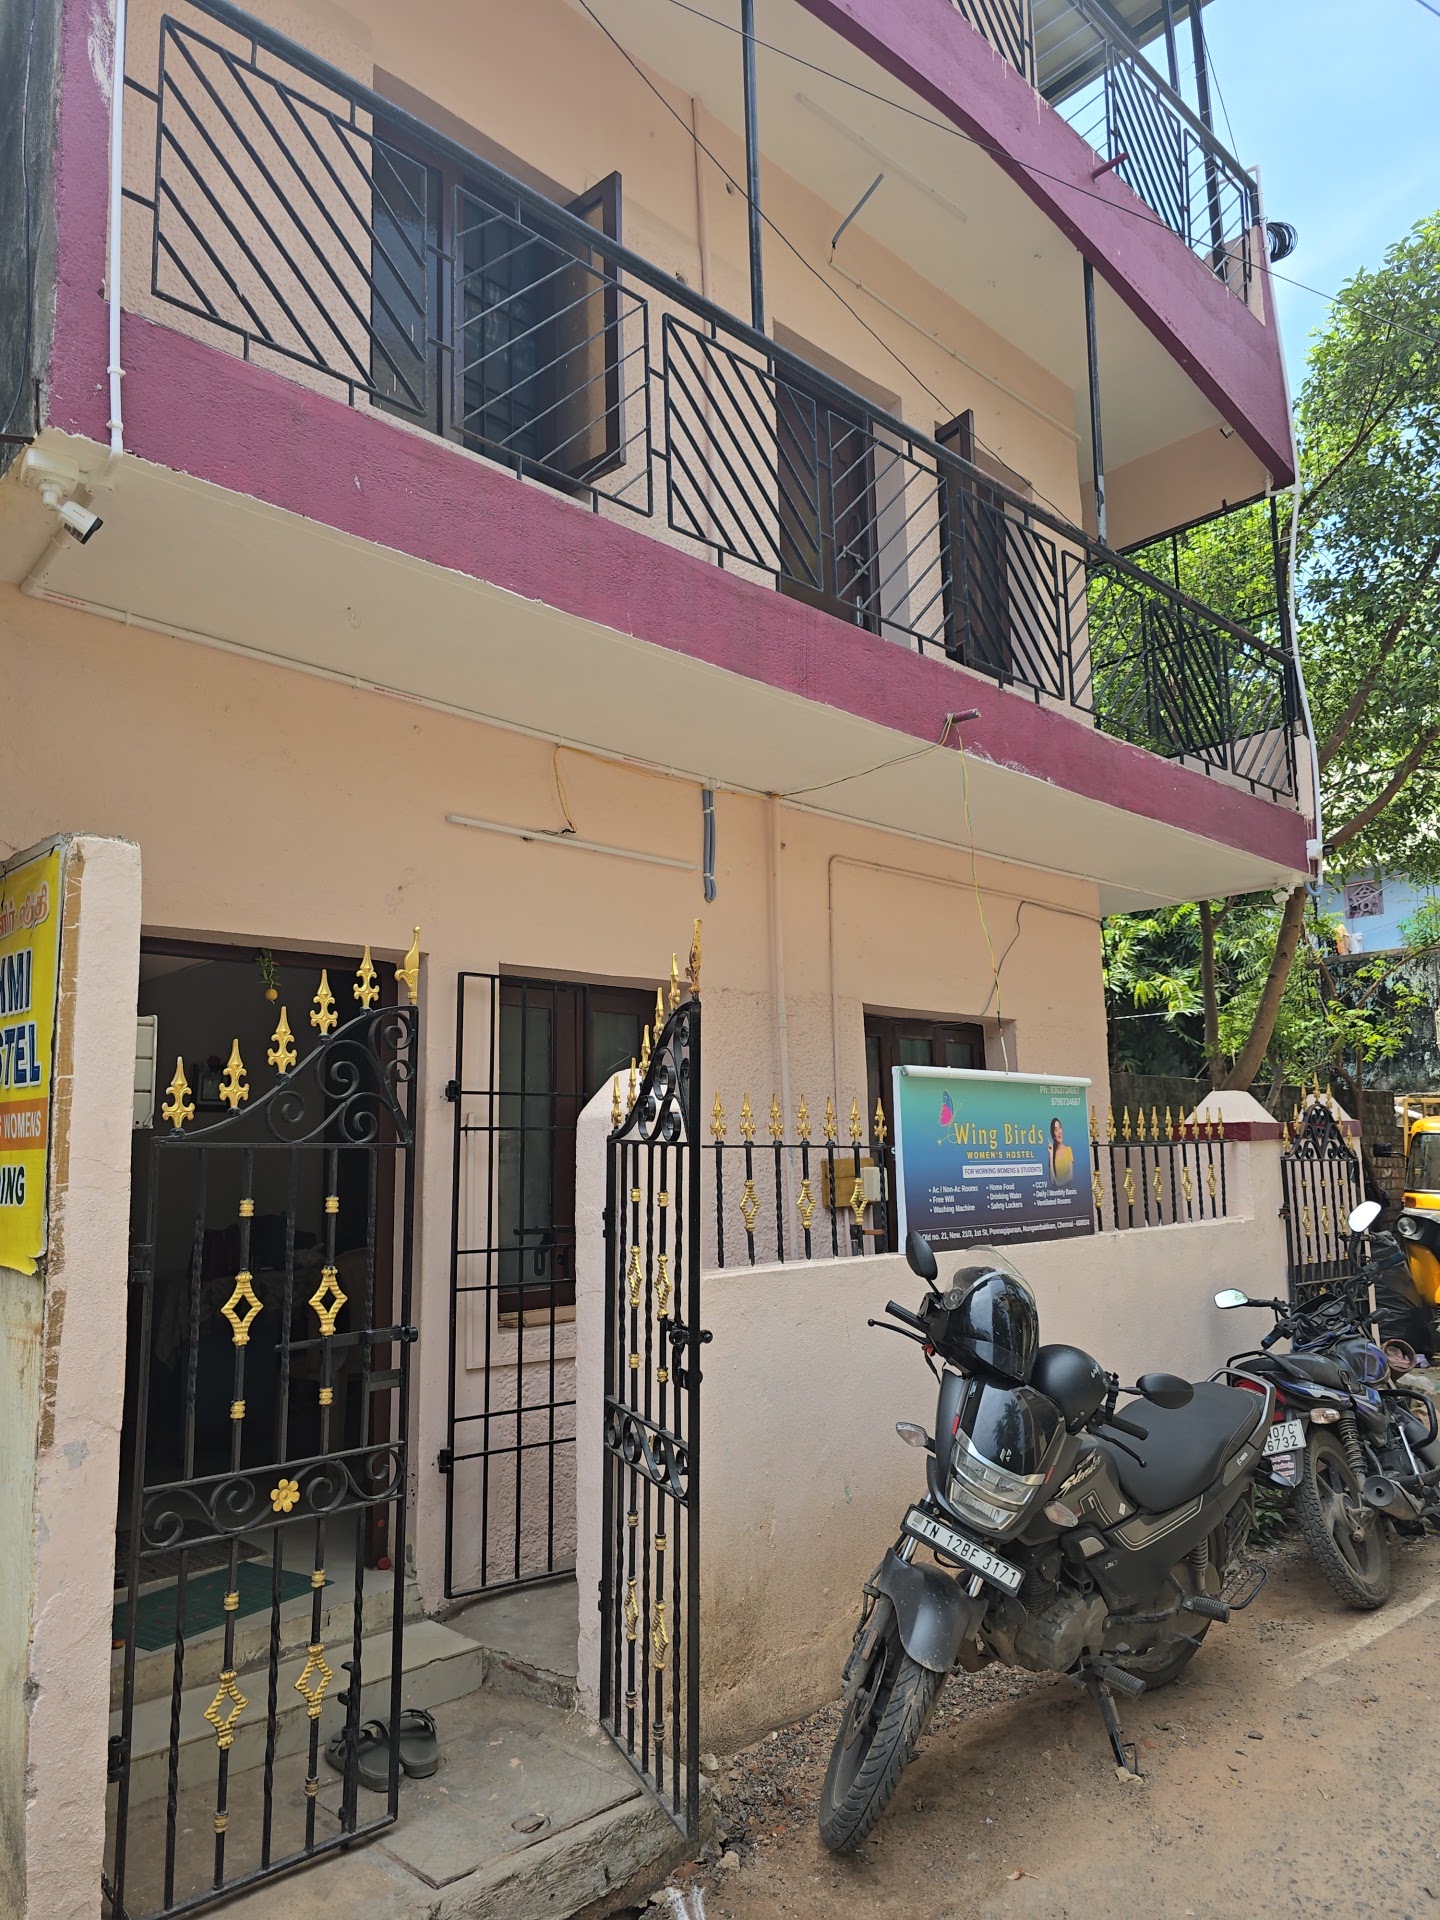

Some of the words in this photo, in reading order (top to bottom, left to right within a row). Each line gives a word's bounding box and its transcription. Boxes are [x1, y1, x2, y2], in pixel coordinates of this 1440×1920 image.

[0, 1024, 40, 1086] TEL
[4, 1110, 42, 1139] WOMENS
[954, 1122, 998, 1149] Wing
[1004, 1122, 1044, 1145] Birds
[966, 1151, 1003, 1159] WOMEN'S
[1006, 1150, 1034, 1158] HOSTEL
[932, 1186, 939, 1194] Ac
[932, 1196, 944, 1204] Free
[990, 1193, 1009, 1201] Drinking
[933, 1206, 955, 1214] Washing
[955, 1204, 975, 1212] Machine
[991, 1202, 1004, 1210] Safety
[1264, 1435, 1298, 1452] 6732
[921, 1520, 941, 1539] TN
[946, 1535, 980, 1561] 12BF
[982, 1557, 1018, 1584] 3171
